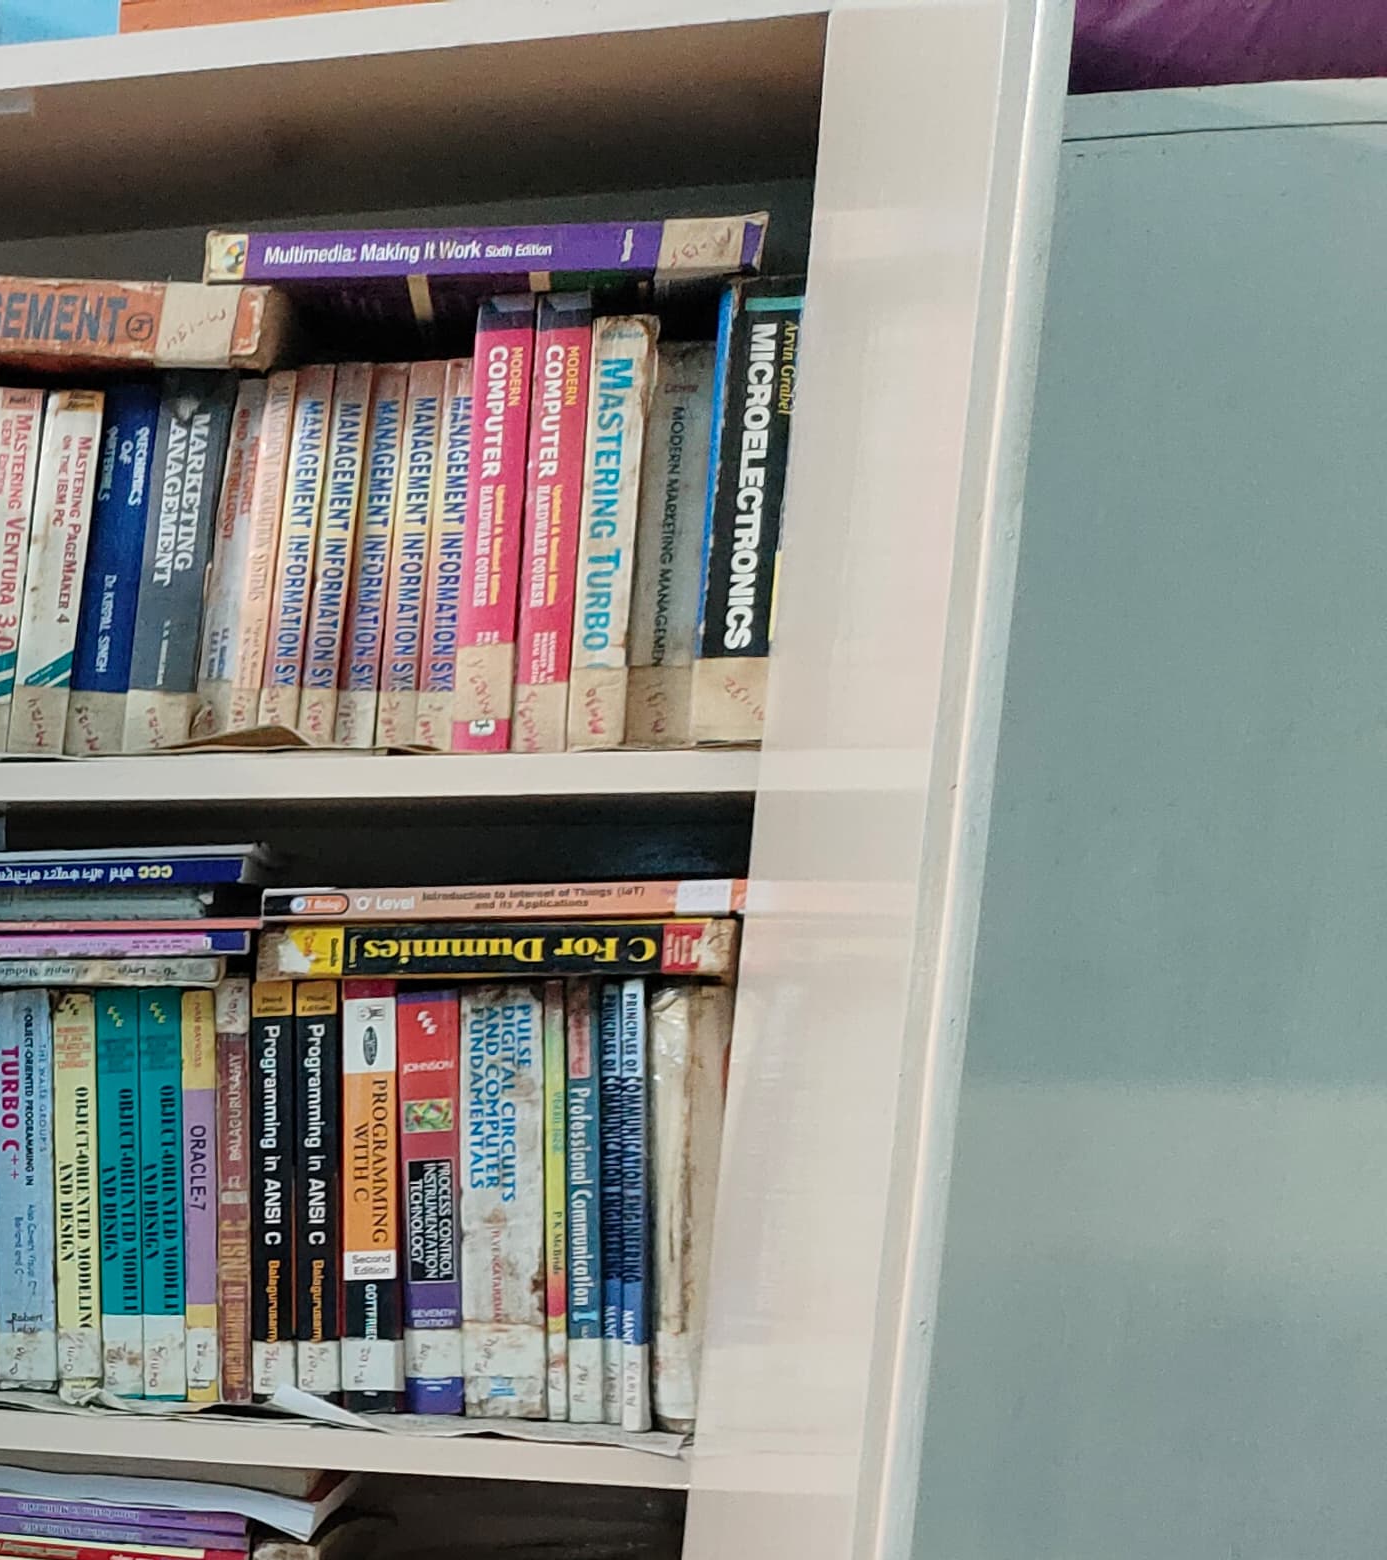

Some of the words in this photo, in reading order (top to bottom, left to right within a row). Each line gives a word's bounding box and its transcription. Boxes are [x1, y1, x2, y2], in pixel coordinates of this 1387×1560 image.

[263, 244, 356, 265] Multimedia:
[360, 242, 420, 262] Making
[424, 241, 436, 259] It
[440, 240, 482, 259] Work
[515, 243, 552, 257] Edition
[481, 346, 509, 478] COMPUTER
[537, 344, 565, 477] COMPUTER
[591, 357, 635, 539] MASTERING
[172, 414, 212, 572] MARKETING
[723, 322, 778, 651] MICROELECTRONICS
[0, 515, 28, 606] VENTURA
[583, 547, 622, 652] TURBO
[363, 935, 545, 961] Dummies
[553, 936, 621, 962] For
[628, 936, 657, 960] C
[485, 1005, 501, 1044] AND
[501, 1005, 516, 1089] DIGITAL
[517, 1003, 532, 1071] PULSE
[0, 1045, 21, 1130] TURBO
[260, 1024, 281, 1150] Programming
[468, 1007, 485, 1190] FUNDAMENTALS
[485, 1049, 501, 1188] COMPUTER
[351, 1123, 370, 1181] WITH
[371, 1078, 389, 1245] PROGRAMMING
[501, 1097, 516, 1203] CIRCUITS
[264, 1176, 281, 1224] ANSI
[266, 1228, 281, 1246] C
[354, 1186, 367, 1203] C
